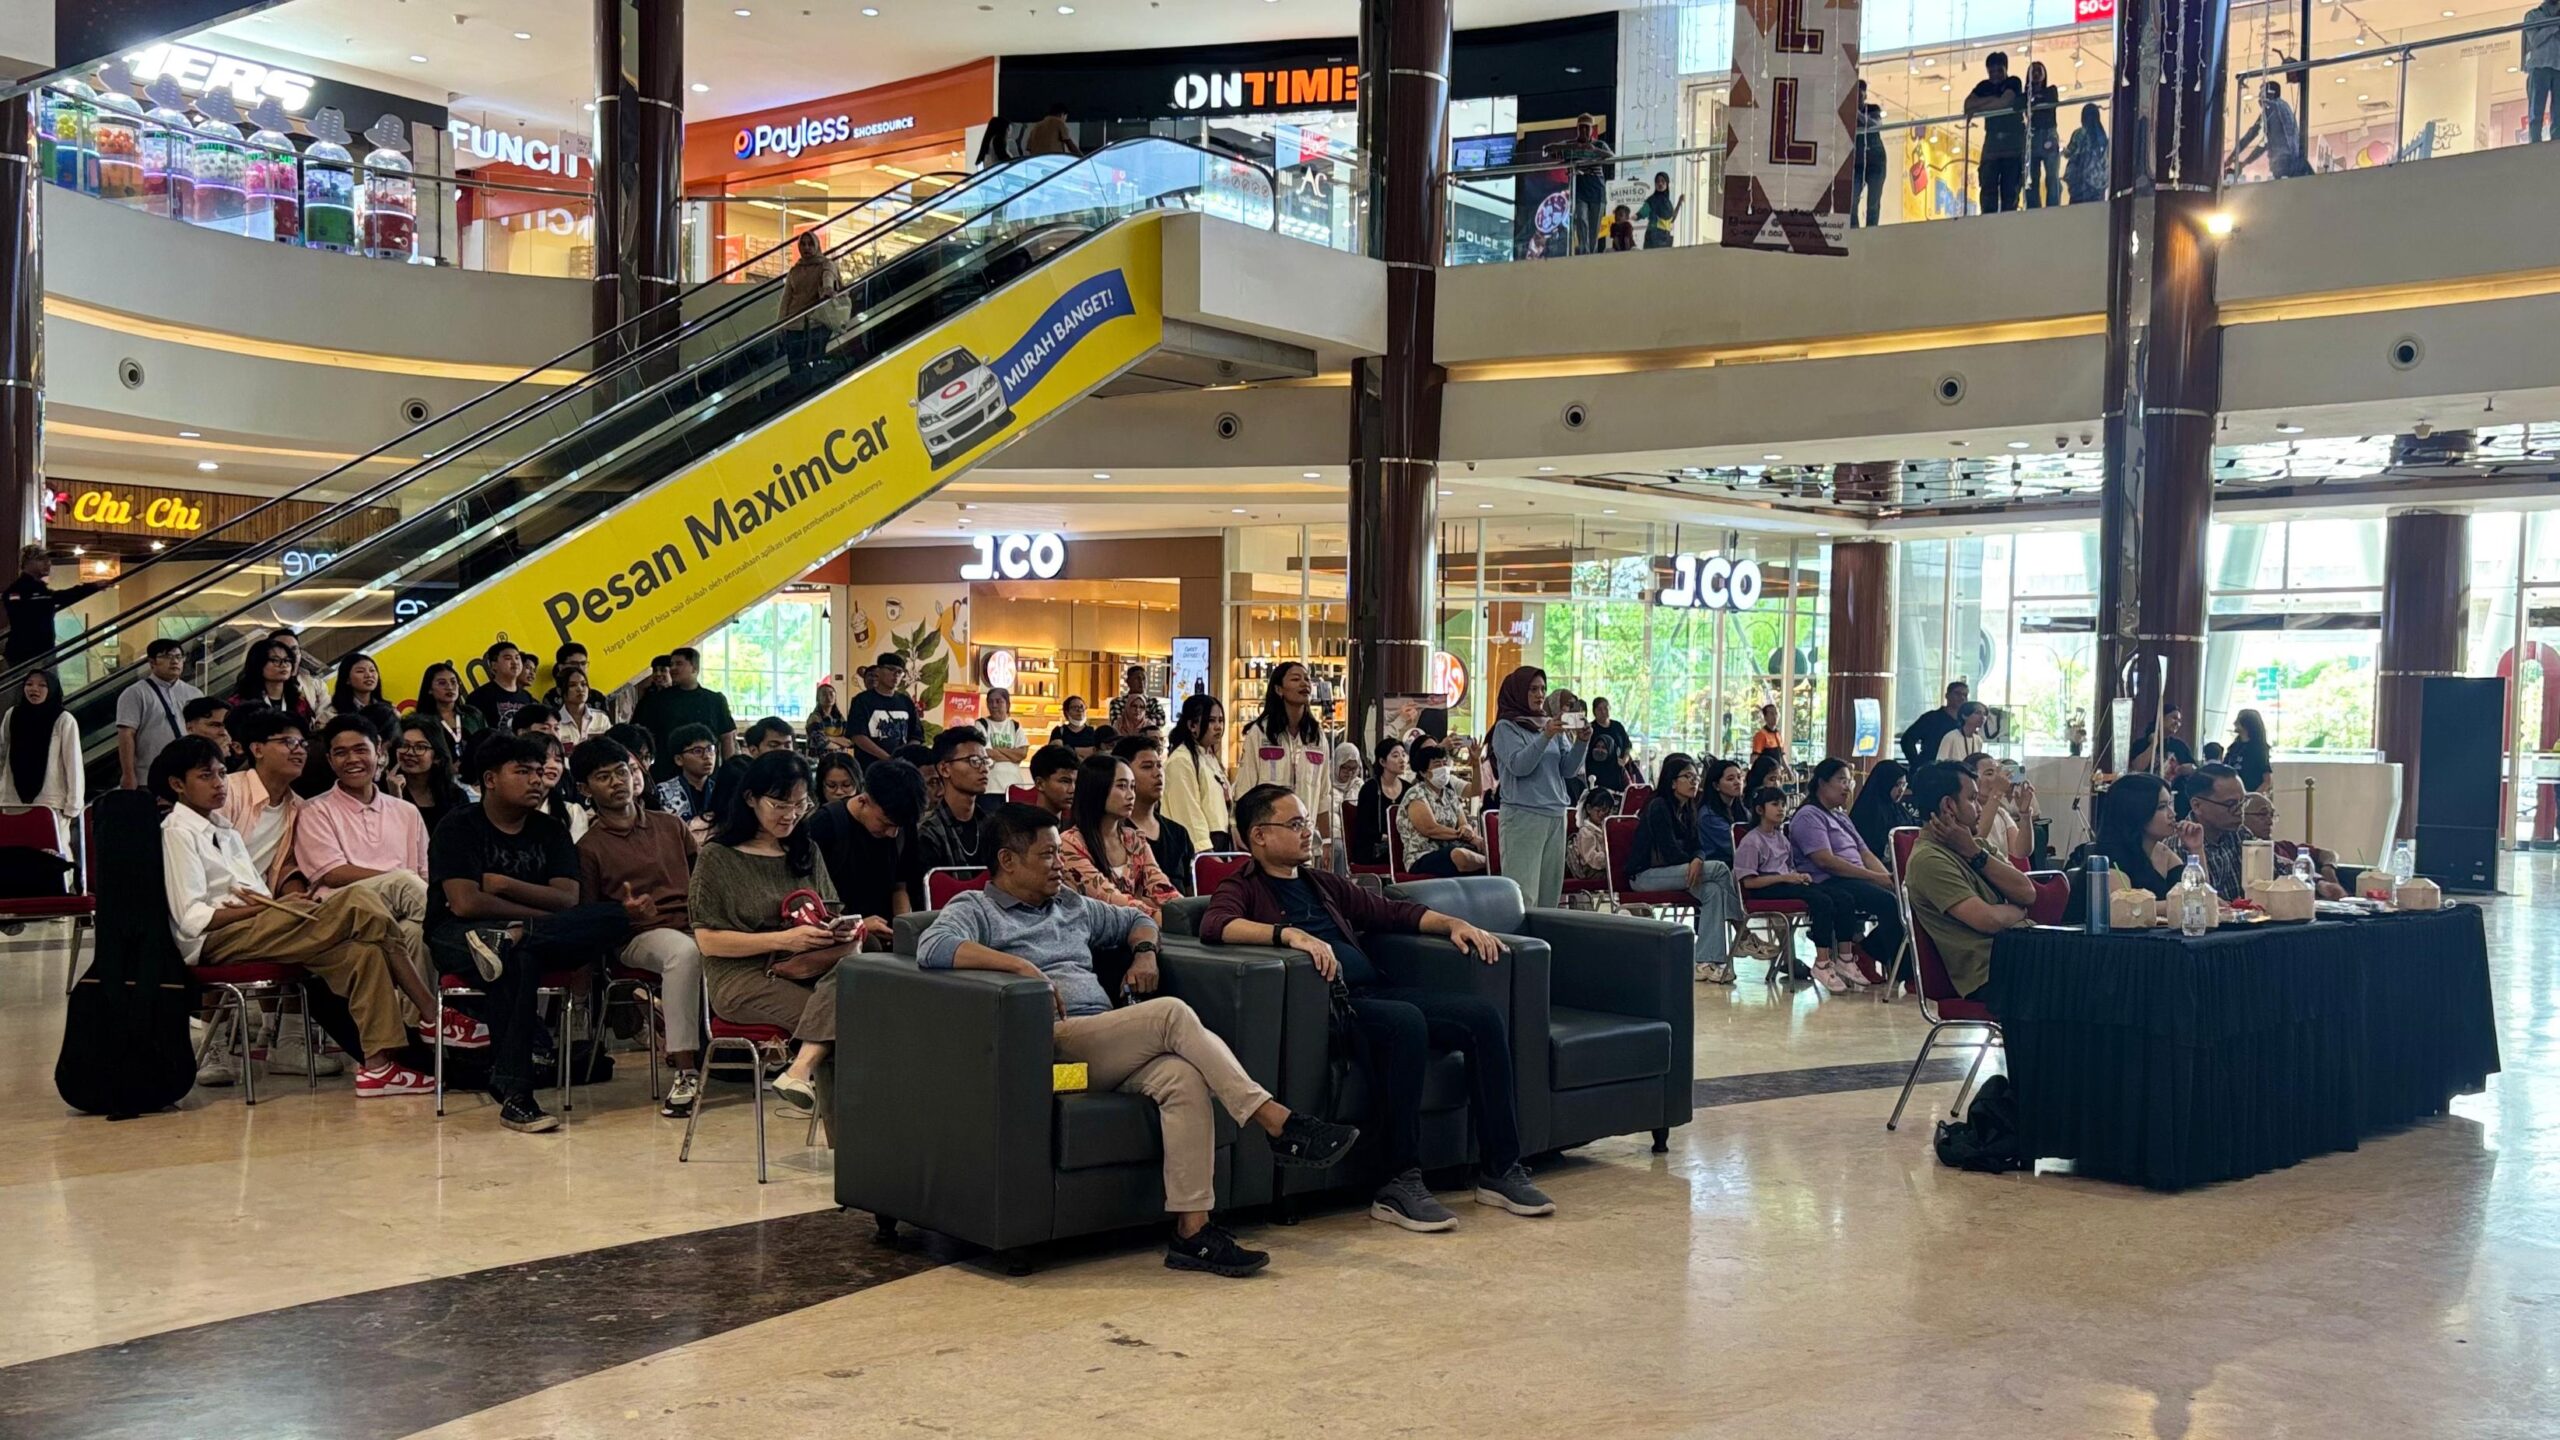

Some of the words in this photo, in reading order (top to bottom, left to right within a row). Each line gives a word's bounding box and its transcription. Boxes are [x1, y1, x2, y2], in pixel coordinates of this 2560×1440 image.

[755, 115, 850, 158] Payless
[853, 116, 914, 139] SHOESOURCE
[1610, 188, 1645, 199] MINISO
[1457, 228, 1498, 250] POLICE
[1003, 331, 1056, 392] MURAH
[1053, 288, 1114, 341] BANGET!
[73, 490, 132, 525] Chi
[145, 497, 202, 531] Chi
[546, 542, 688, 645] Pesan
[684, 415, 890, 560] MaximCar
[960, 532, 1064, 580] J.CO
[1661, 555, 1761, 610] J.CO
[603, 638, 626, 655] Harga
[625, 630, 640, 642] dan
[640, 619, 656, 633] tarif
[655, 611, 670, 624] bisa
